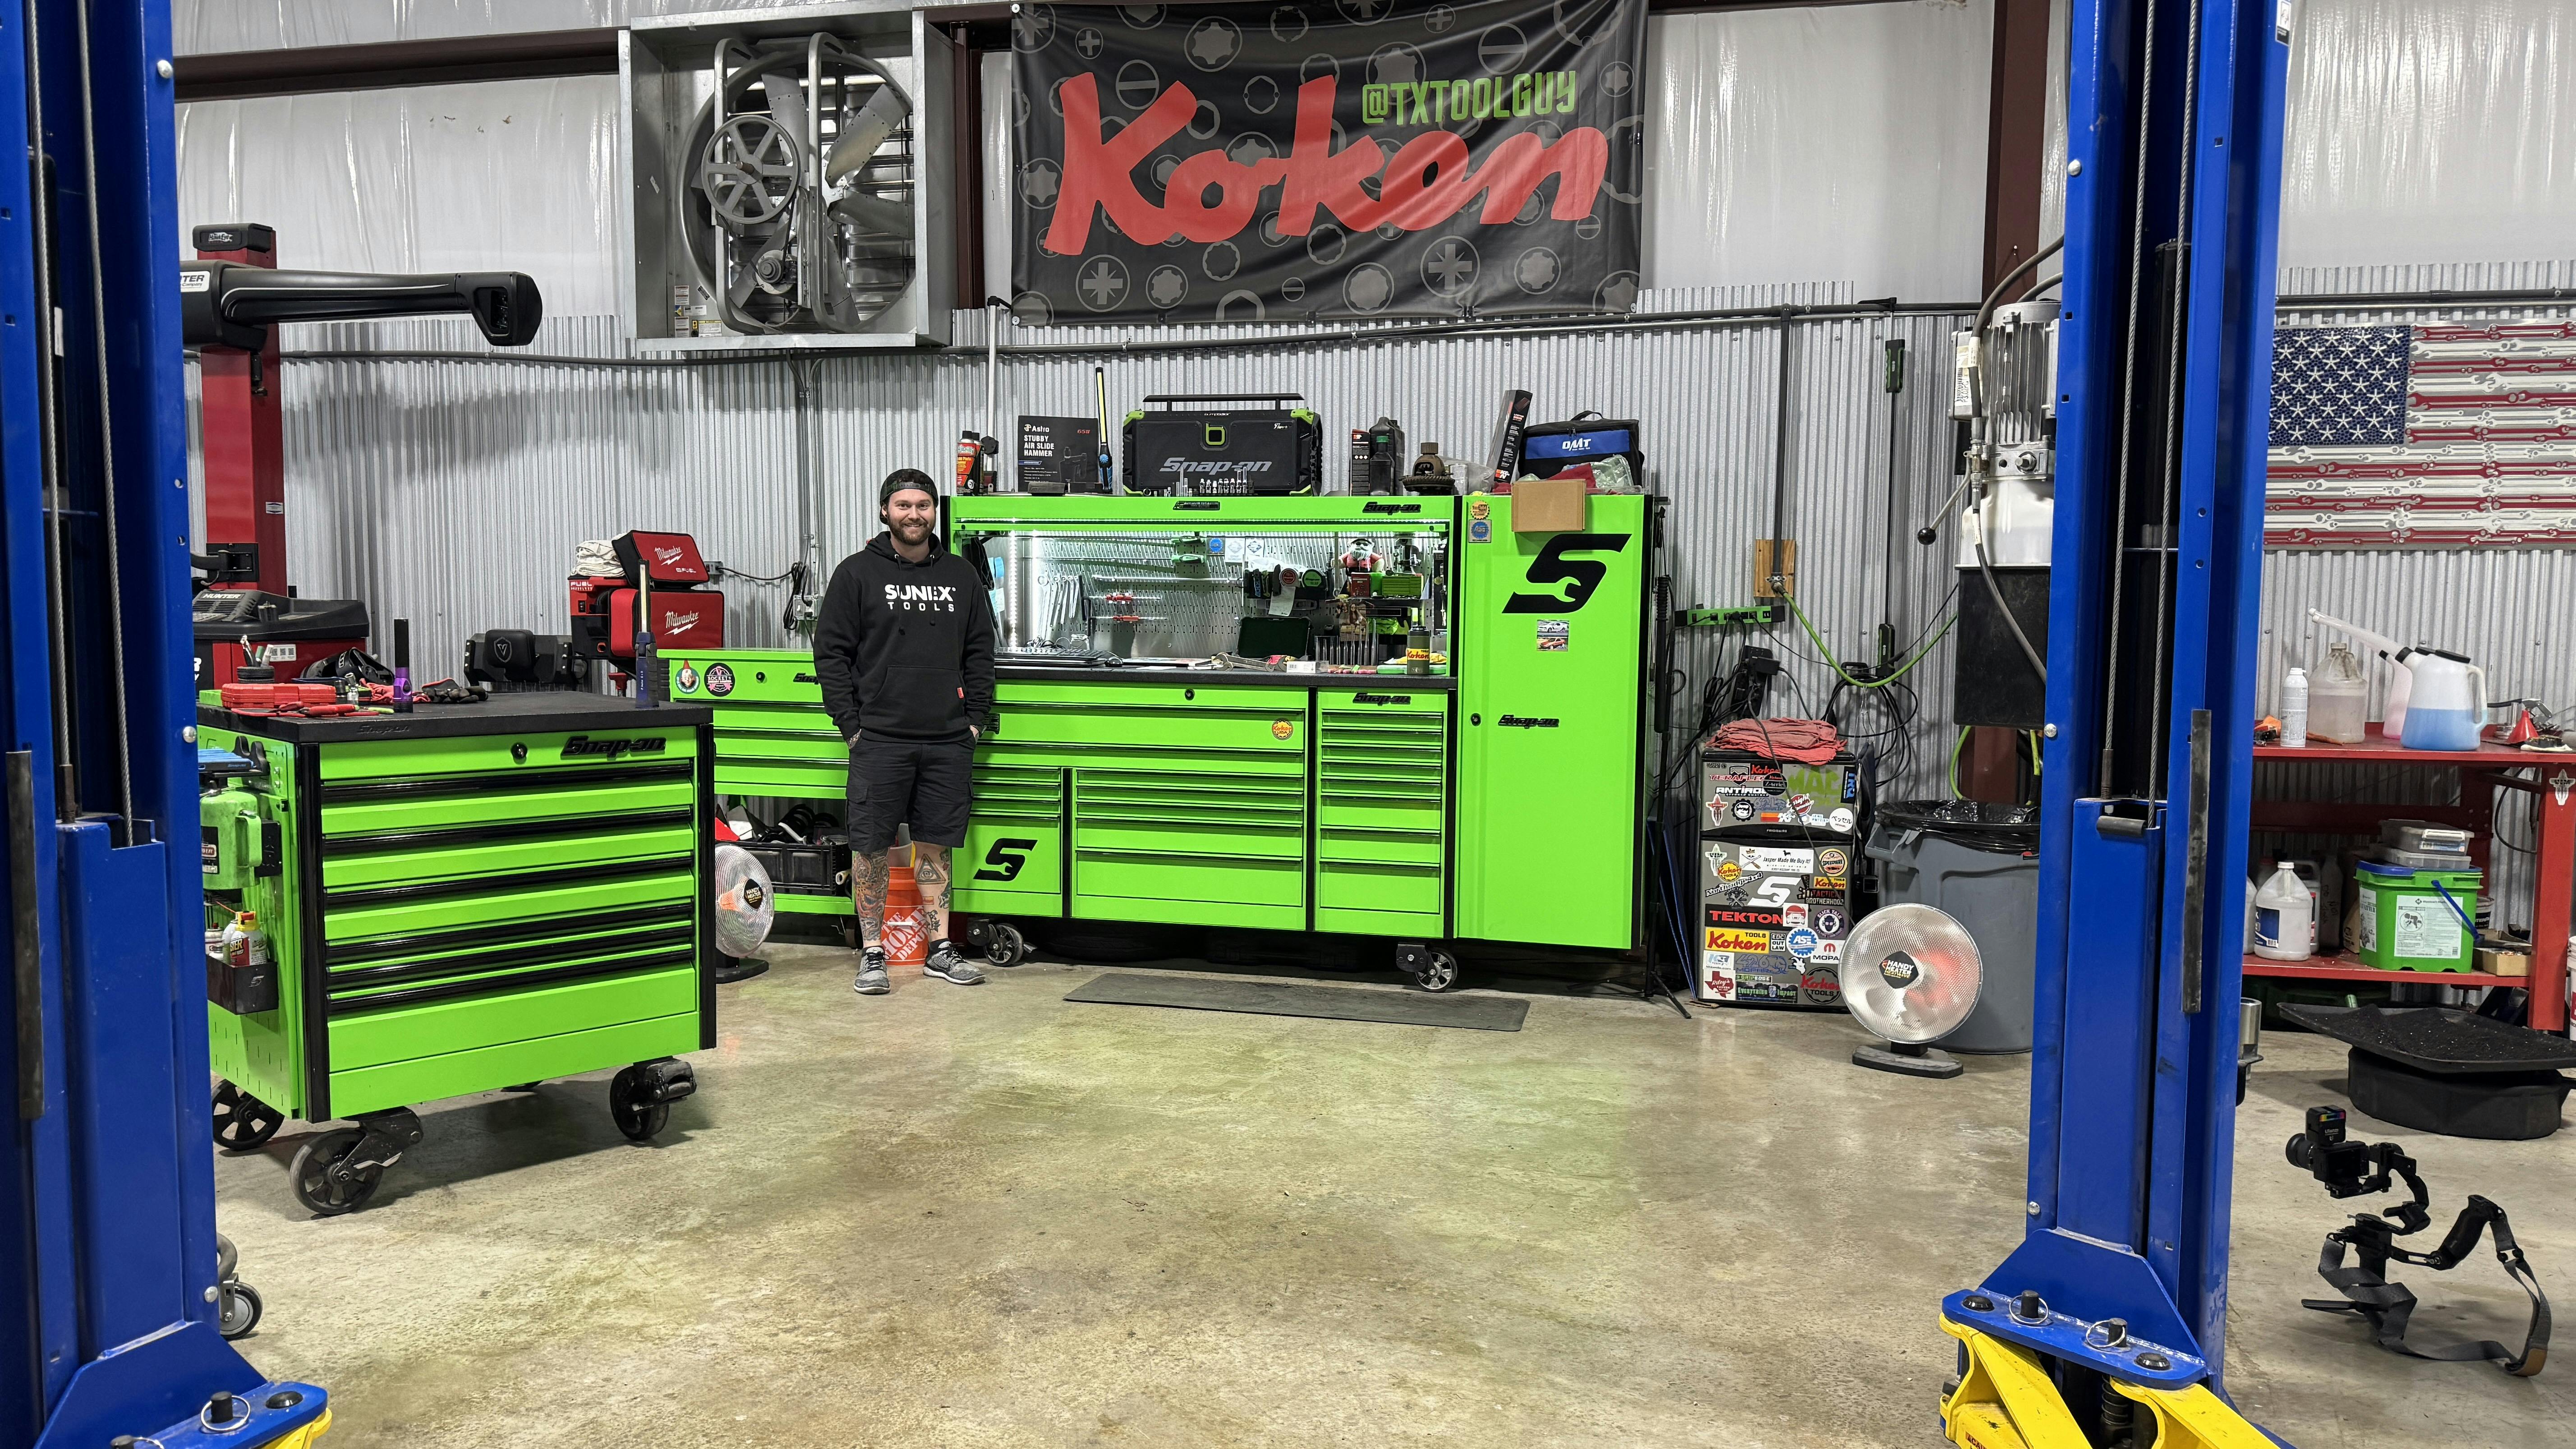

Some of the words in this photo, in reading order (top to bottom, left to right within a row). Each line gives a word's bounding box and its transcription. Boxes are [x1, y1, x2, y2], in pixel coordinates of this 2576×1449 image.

[1362, 71, 1576, 126] @TXTOOLGUY
[1044, 72, 1608, 255] Koken
[1159, 457, 1272, 475] Snap-on
[1362, 501, 1421, 515] Snap-on
[654, 545, 682, 561] Milwaukee
[884, 584, 954, 602] SUNEX
[887, 602, 955, 612] TOOLS
[665, 610, 699, 629] Milwaukee
[1352, 691, 1411, 706] Snap-on
[1498, 715, 1559, 729] Snap-on
[561, 736, 667, 758] Snap-on
[1709, 910, 1783, 924] TEKTON
[1707, 930, 1766, 951] Koken
[1793, 935, 1812, 944] ASE
[1887, 960, 1914, 971] HANDY
